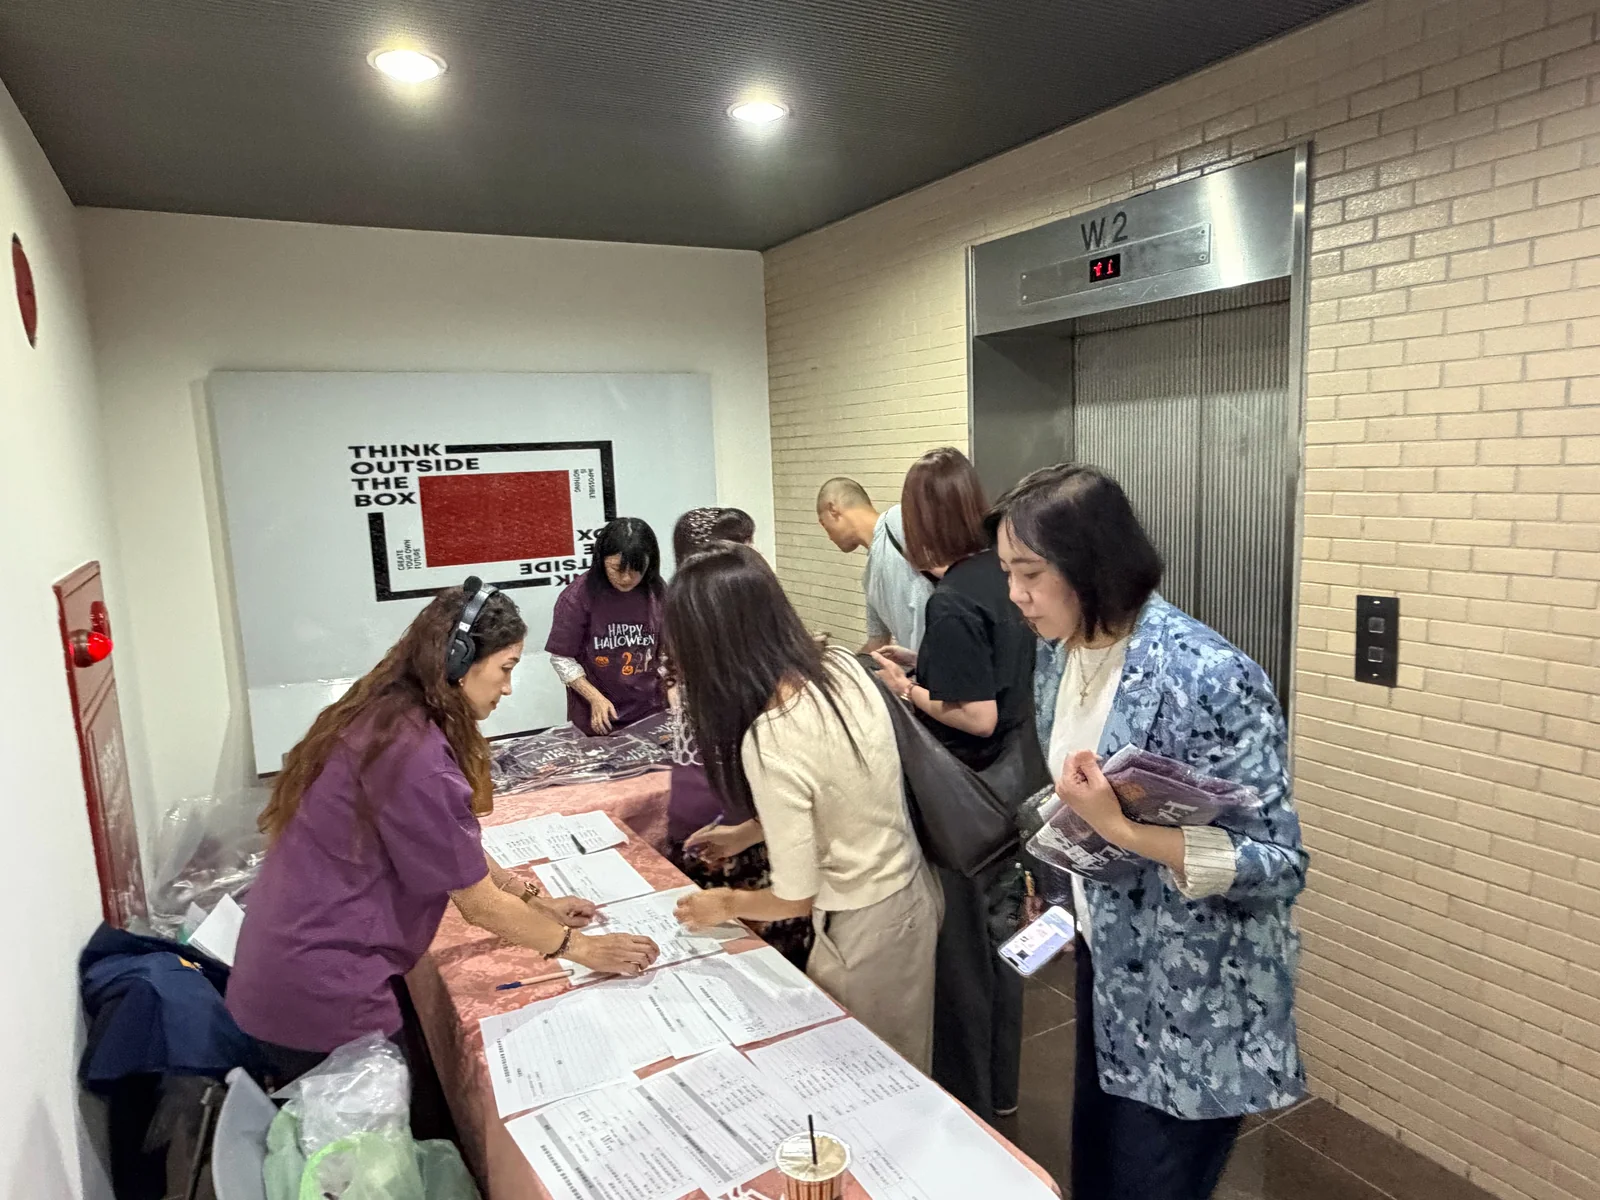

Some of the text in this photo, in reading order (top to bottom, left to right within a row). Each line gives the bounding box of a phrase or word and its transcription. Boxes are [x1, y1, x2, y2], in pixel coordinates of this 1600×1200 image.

[348, 443, 442, 459] THINK
[350, 458, 480, 475] OUTSIDE
[351, 476, 409, 491] THE
[573, 468, 581, 493] NOTHING
[587, 468, 596, 499] IMPOSSIBLE
[354, 491, 417, 507] BOX
[396, 550, 405, 571] CREATE
[404, 539, 414, 571] YOUR OWN
[412, 547, 422, 570] FUTURE
[519, 558, 593, 575] TSIDE
[607, 623, 643, 637] HAPPY
[593, 634, 655, 650] HALLOWEEN
